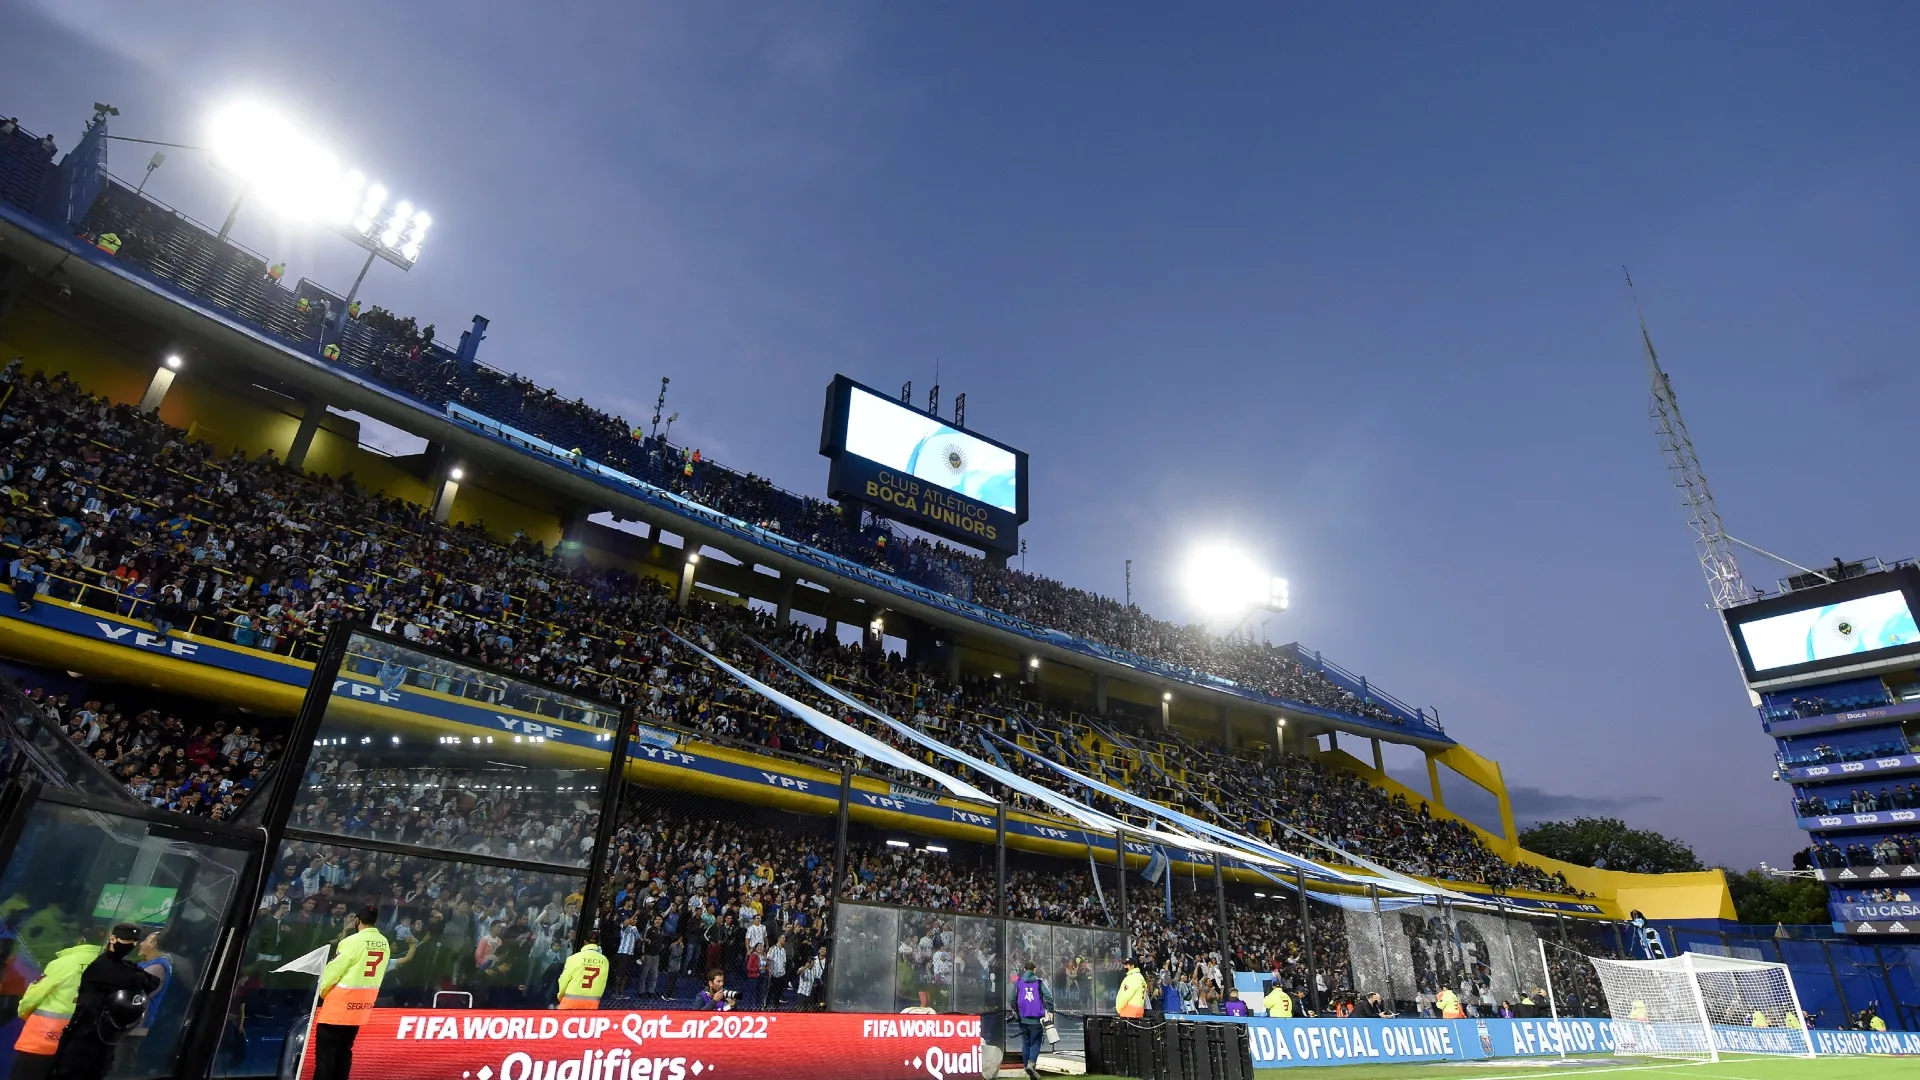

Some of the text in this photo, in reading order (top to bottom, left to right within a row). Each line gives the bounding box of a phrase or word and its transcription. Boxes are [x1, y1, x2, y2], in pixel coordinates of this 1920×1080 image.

[878, 471, 988, 521] CLUB ATLÉTICO
[866, 480, 997, 540] BOCA JUNIORS
[96, 621, 199, 655] YPF
[496, 715, 563, 738] YPF
[639, 745, 696, 764] YPF
[761, 772, 809, 791] YPF
[863, 794, 906, 810] YPF
[954, 810, 992, 826] YPF
[1034, 825, 1068, 839] YPF
[1124, 842, 1153, 854] YPF
[1537, 900, 1559, 909] YPF
[1575, 904, 1597, 912] YPF
[1856, 906, 1878, 917] TU
[366, 940, 387, 948] TECH
[364, 951, 384, 977] 3
[581, 967, 600, 988] 3
[1282, 1000, 1289, 1011] 3
[397, 1015, 459, 1039] FIFA
[462, 1016, 559, 1039] WORLD
[562, 1016, 612, 1039] CUP
[863, 1019, 899, 1037] FIFA
[900, 1019, 956, 1038] WORLD
[1294, 1026, 1379, 1060] OFICIAL
[1381, 1025, 1453, 1058] ONLINE
[500, 1048, 686, 1080] Qualifiers
